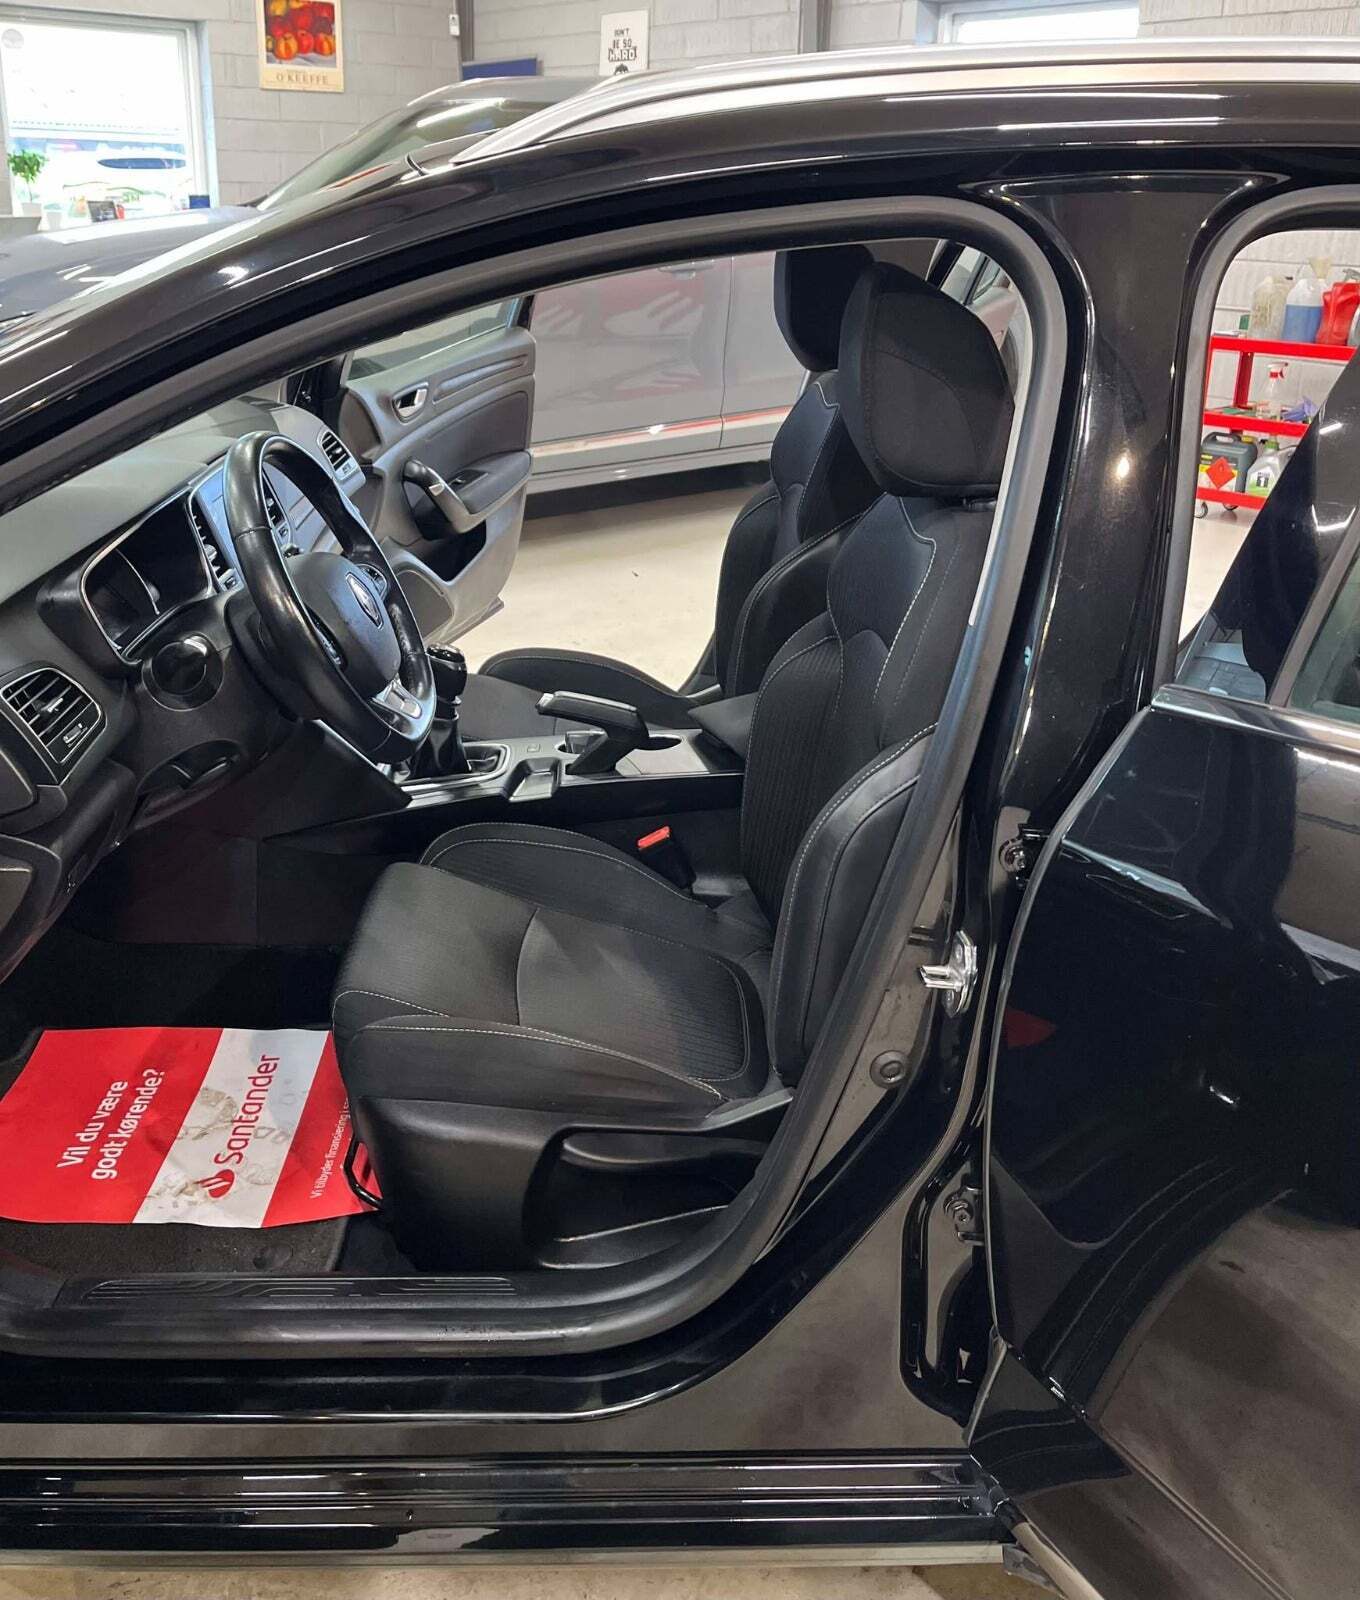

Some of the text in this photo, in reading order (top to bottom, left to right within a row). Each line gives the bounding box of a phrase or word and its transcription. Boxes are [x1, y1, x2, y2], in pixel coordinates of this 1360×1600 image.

[622, 39, 632, 48] SO
[56, 1081, 128, 1168] Vil du være
[90, 1068, 165, 1180] godt kørende?
[213, 1054, 281, 1165] Santander
